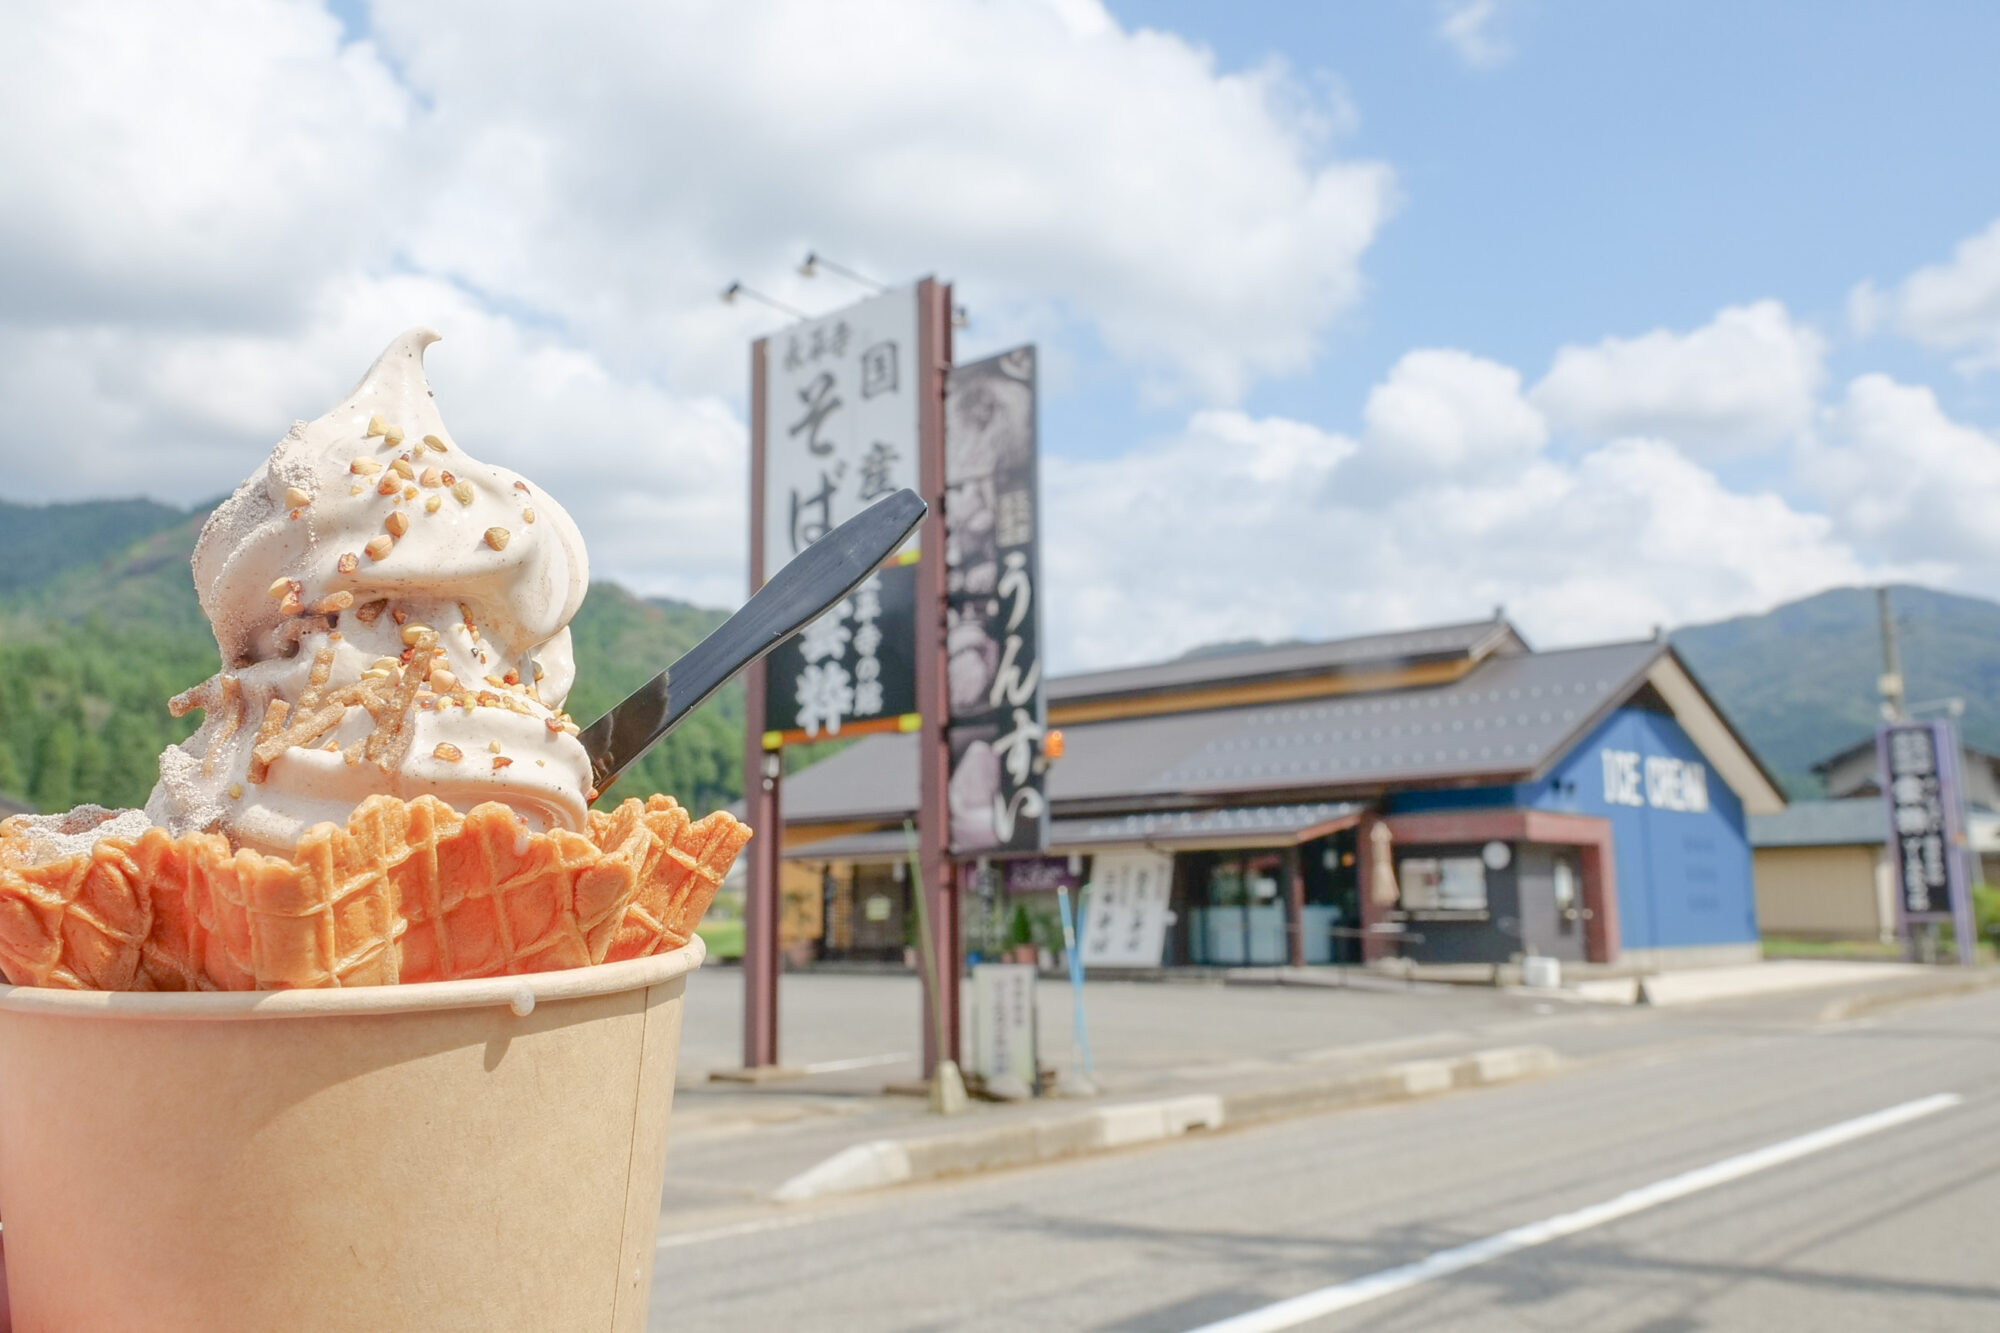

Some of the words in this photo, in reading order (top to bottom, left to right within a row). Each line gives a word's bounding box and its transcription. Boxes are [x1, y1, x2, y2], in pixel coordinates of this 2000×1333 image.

[989, 550, 1045, 844] うんすい
[1602, 748, 1643, 807] ICE
[1645, 756, 1708, 813] CREAM
